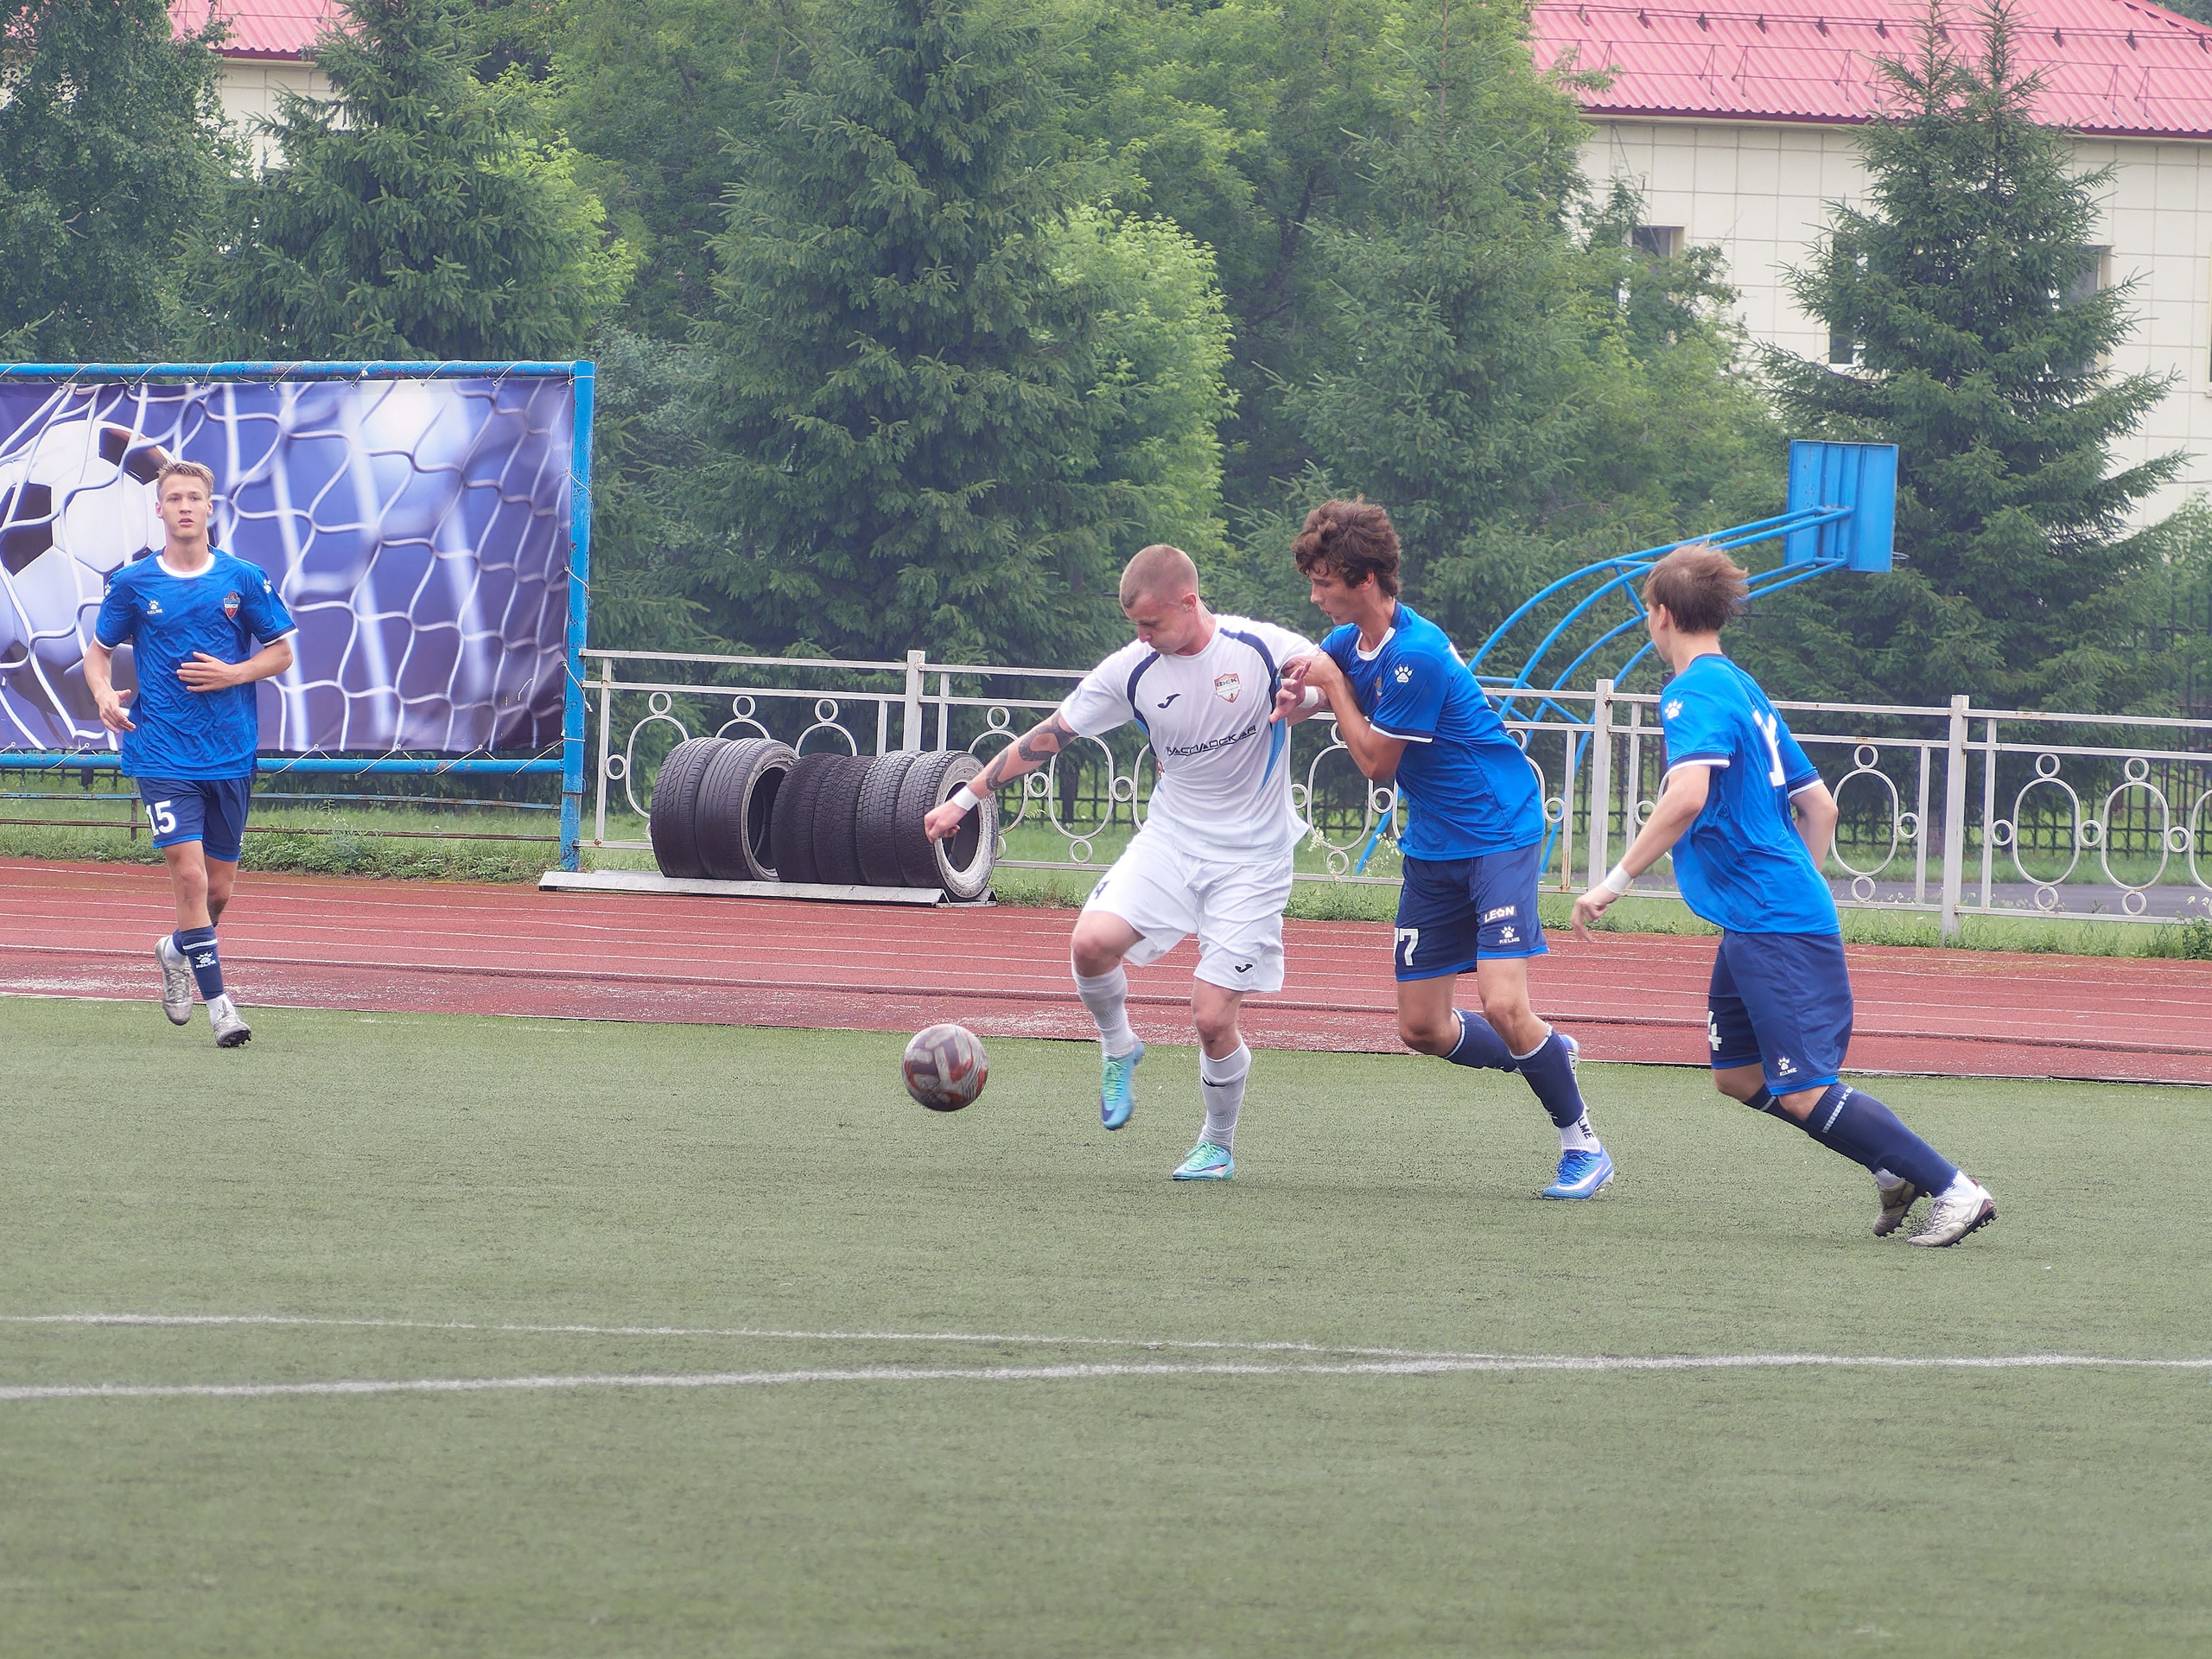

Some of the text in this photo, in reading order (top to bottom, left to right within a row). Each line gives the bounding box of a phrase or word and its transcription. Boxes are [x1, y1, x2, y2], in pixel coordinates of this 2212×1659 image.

[145, 800, 176, 836] 15
[1484, 906, 1515, 924] LEON
[1498, 936, 1521, 944] KELME
